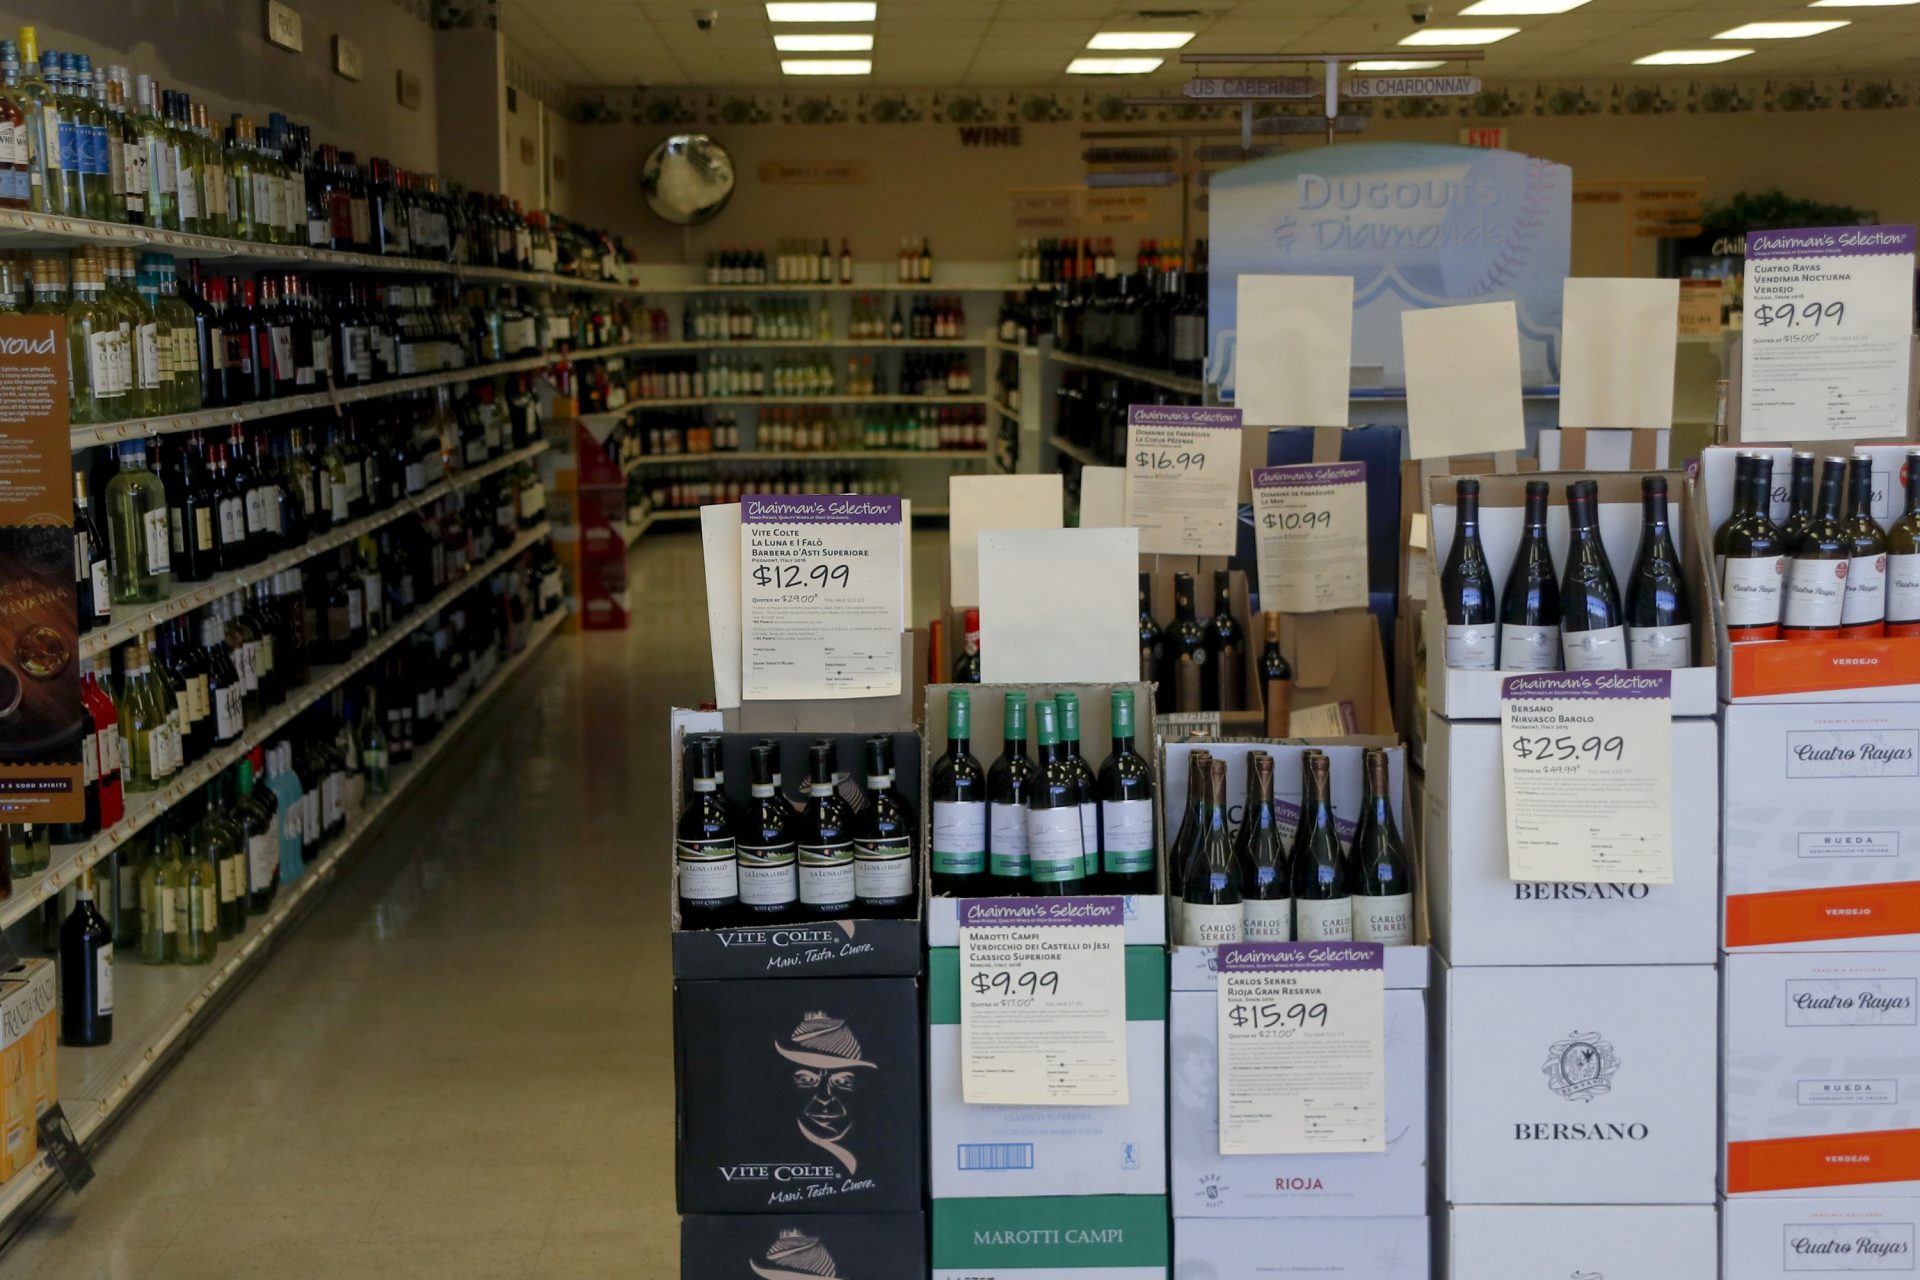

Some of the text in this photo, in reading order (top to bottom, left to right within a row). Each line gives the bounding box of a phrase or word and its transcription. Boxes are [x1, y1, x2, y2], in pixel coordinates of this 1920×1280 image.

[1192, 79, 1312, 95] US CABERNET
[1350, 77, 1471, 95] US CHARDONNAY
[960, 126, 1021, 147] WINE
[1298, 174, 1498, 210] DUGOUTS
[1273, 210, 1506, 251] & Diamonds
[1753, 235, 1834, 251] Chairman's
[1755, 265, 1790, 273] CUATRO
[1754, 273, 1851, 283] VENDIMIA NOCTURNA
[1754, 286, 1793, 294] VERDEJO
[1754, 301, 1845, 328] $9.99
[1135, 411, 1189, 421] Chairman's
[1136, 452, 1205, 470] $16.99
[1258, 471, 1313, 483] Chairman's
[748, 501, 825, 516] Chairman's
[1263, 511, 1331, 530] $10.99
[752, 538, 822, 546] LA LUNA E I FALÒ
[753, 564, 850, 589] $12.99
[1732, 584, 1777, 594] Cuatro Rayas
[1510, 677, 1591, 690] Chairman's
[1511, 705, 1553, 713] BERSANO
[1511, 715, 1594, 723] NIRVASCO BAROLO
[1513, 736, 1624, 761] $25.99
[1793, 742, 1913, 764] Cuatro Rayas
[1515, 882, 1649, 900] BERSANO
[968, 904, 1046, 918] Chairman's
[1825, 908, 1872, 916] VERDEJO
[1244, 919, 1280, 927] CARLOS
[1370, 915, 1406, 924] CARLOS
[1200, 924, 1236, 932] CARLOS
[1244, 927, 1280, 935] SERRES
[1371, 923, 1406, 931] SERRES
[716, 931, 833, 948] VITE COLTE
[1200, 932, 1236, 940] SERRES
[970, 942, 1110, 950] VERDICCHIO DEI CASTELLI DI JESI
[970, 953, 1061, 961] CLASSICO SUPERIORE
[1226, 949, 1304, 964] Chairman's
[971, 971, 1059, 996] $9.99
[1228, 977, 1297, 985] CARLOS SERRES
[1228, 987, 1322, 996] RIOJA GRAN RESERVA
[1792, 991, 1911, 1013] Cuatro Rayas
[1229, 1003, 1328, 1029] $15.99
[1513, 1122, 1649, 1141] BERSANO
[1824, 1155, 1870, 1163] VERDEJO
[719, 1165, 834, 1182] VITE COLTE
[1275, 1178, 1323, 1190] RIOJA
[973, 1229, 1123, 1244] MAROTTI CAMPI
[1790, 1236, 1908, 1257] Cuatro Rayas
